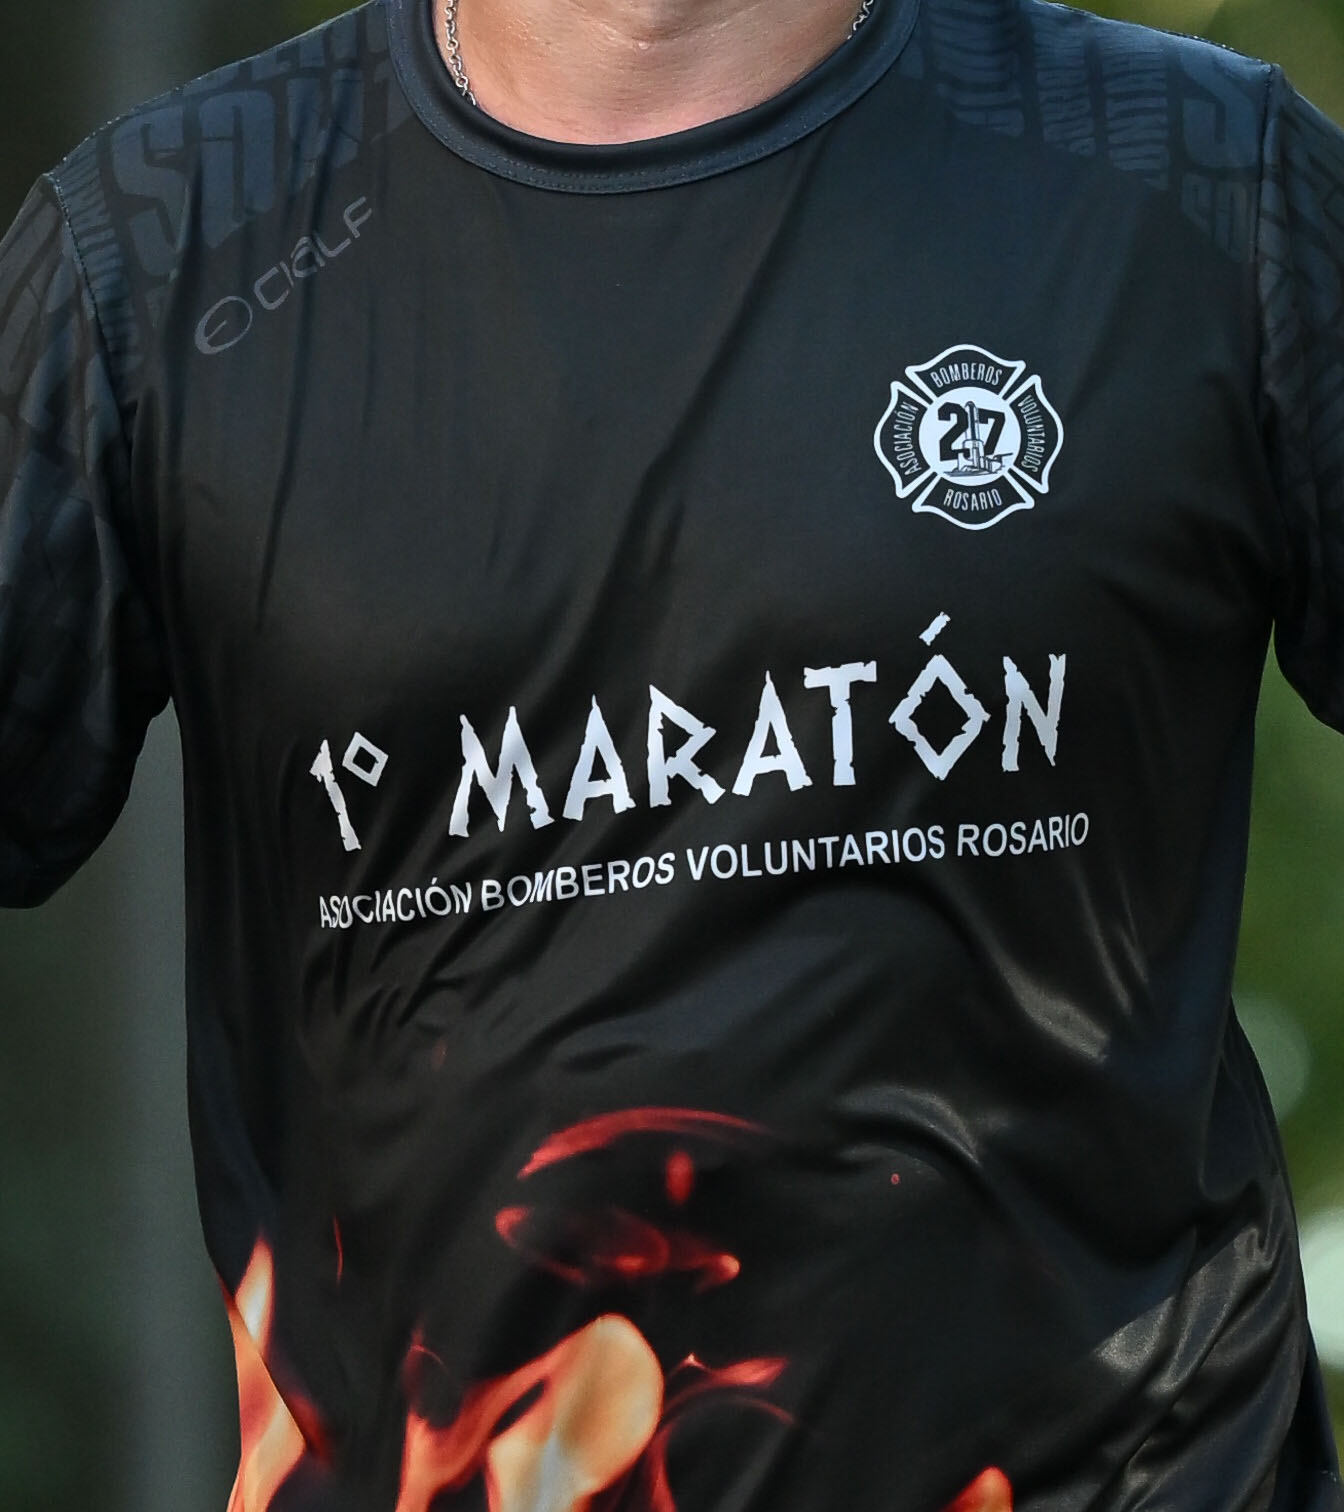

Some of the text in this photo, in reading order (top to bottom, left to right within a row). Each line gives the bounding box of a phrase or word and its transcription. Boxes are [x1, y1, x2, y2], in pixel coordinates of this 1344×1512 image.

[930, 362, 1003, 388] BOMBEROS
[893, 401, 923, 476] ASOCIACIÓN
[937, 401, 1006, 462] 27
[1017, 394, 1046, 473] VOLUNTARIOS
[943, 488, 1003, 511] ROSARIO
[449, 611, 1067, 838] MARATÓN
[319, 812, 1089, 929] ASOCIACIÓN BOMBEROS VOLUNTARIOS ROSARIO
